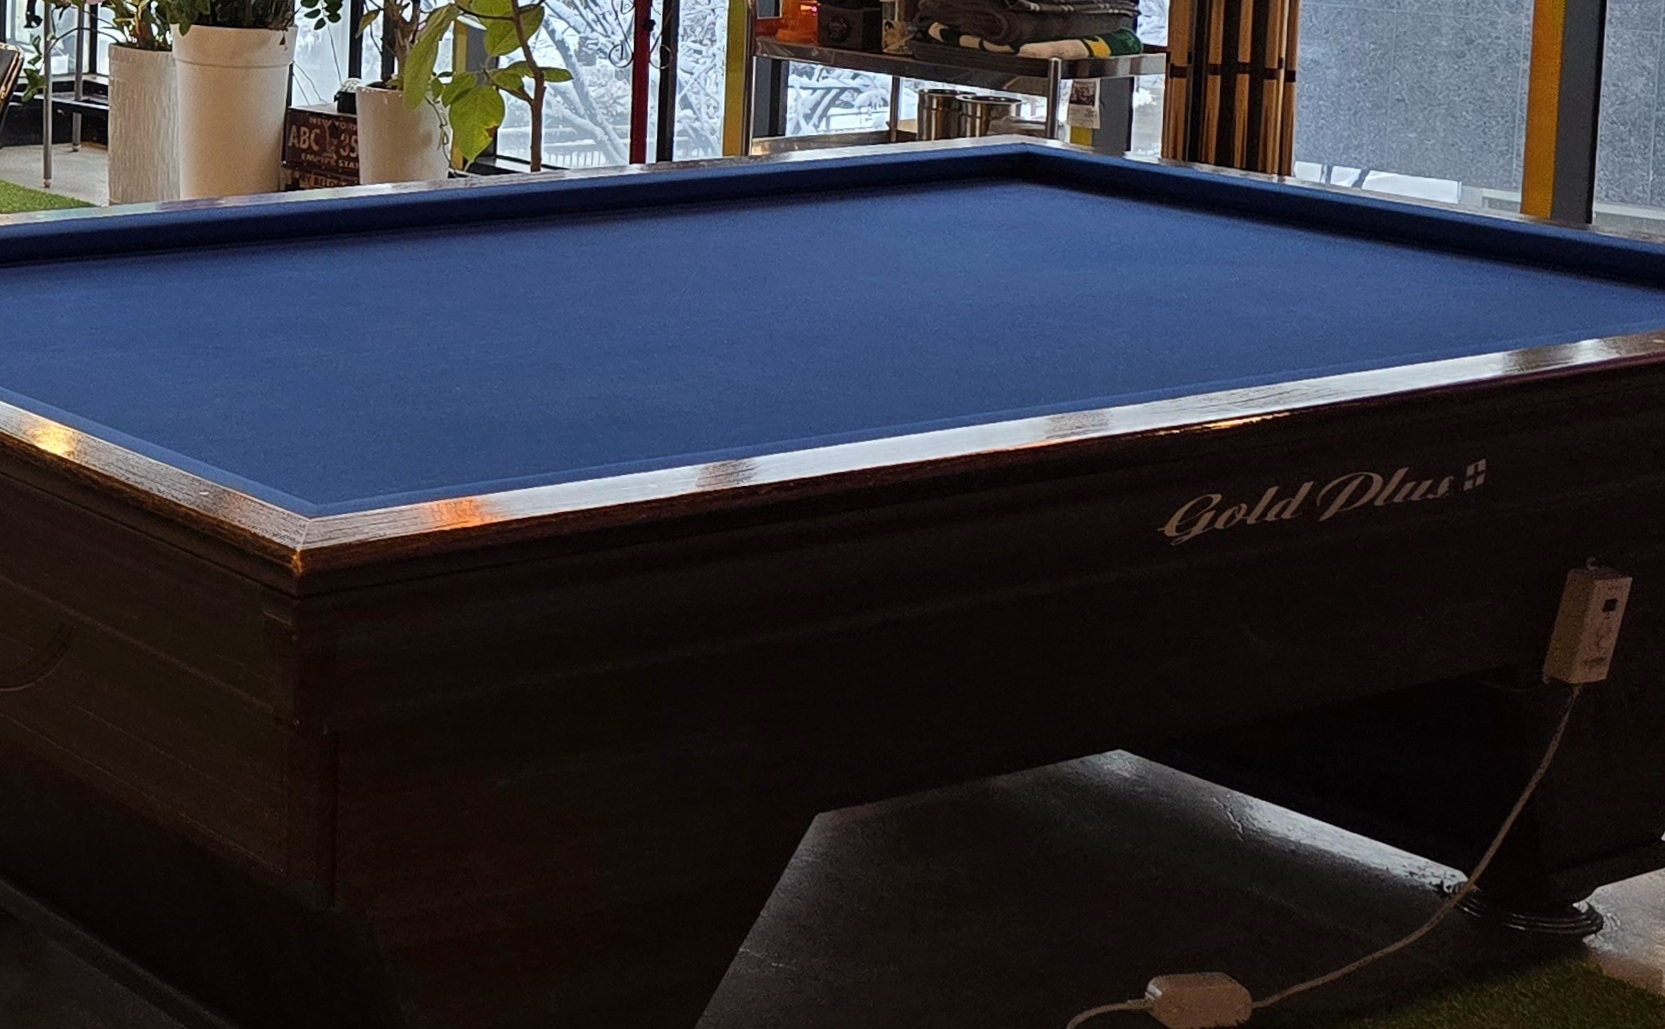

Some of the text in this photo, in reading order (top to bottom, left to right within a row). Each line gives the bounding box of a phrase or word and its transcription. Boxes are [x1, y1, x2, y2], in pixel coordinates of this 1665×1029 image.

[288, 124, 321, 151] ABC
[1157, 466, 1455, 546] Gold Plus
